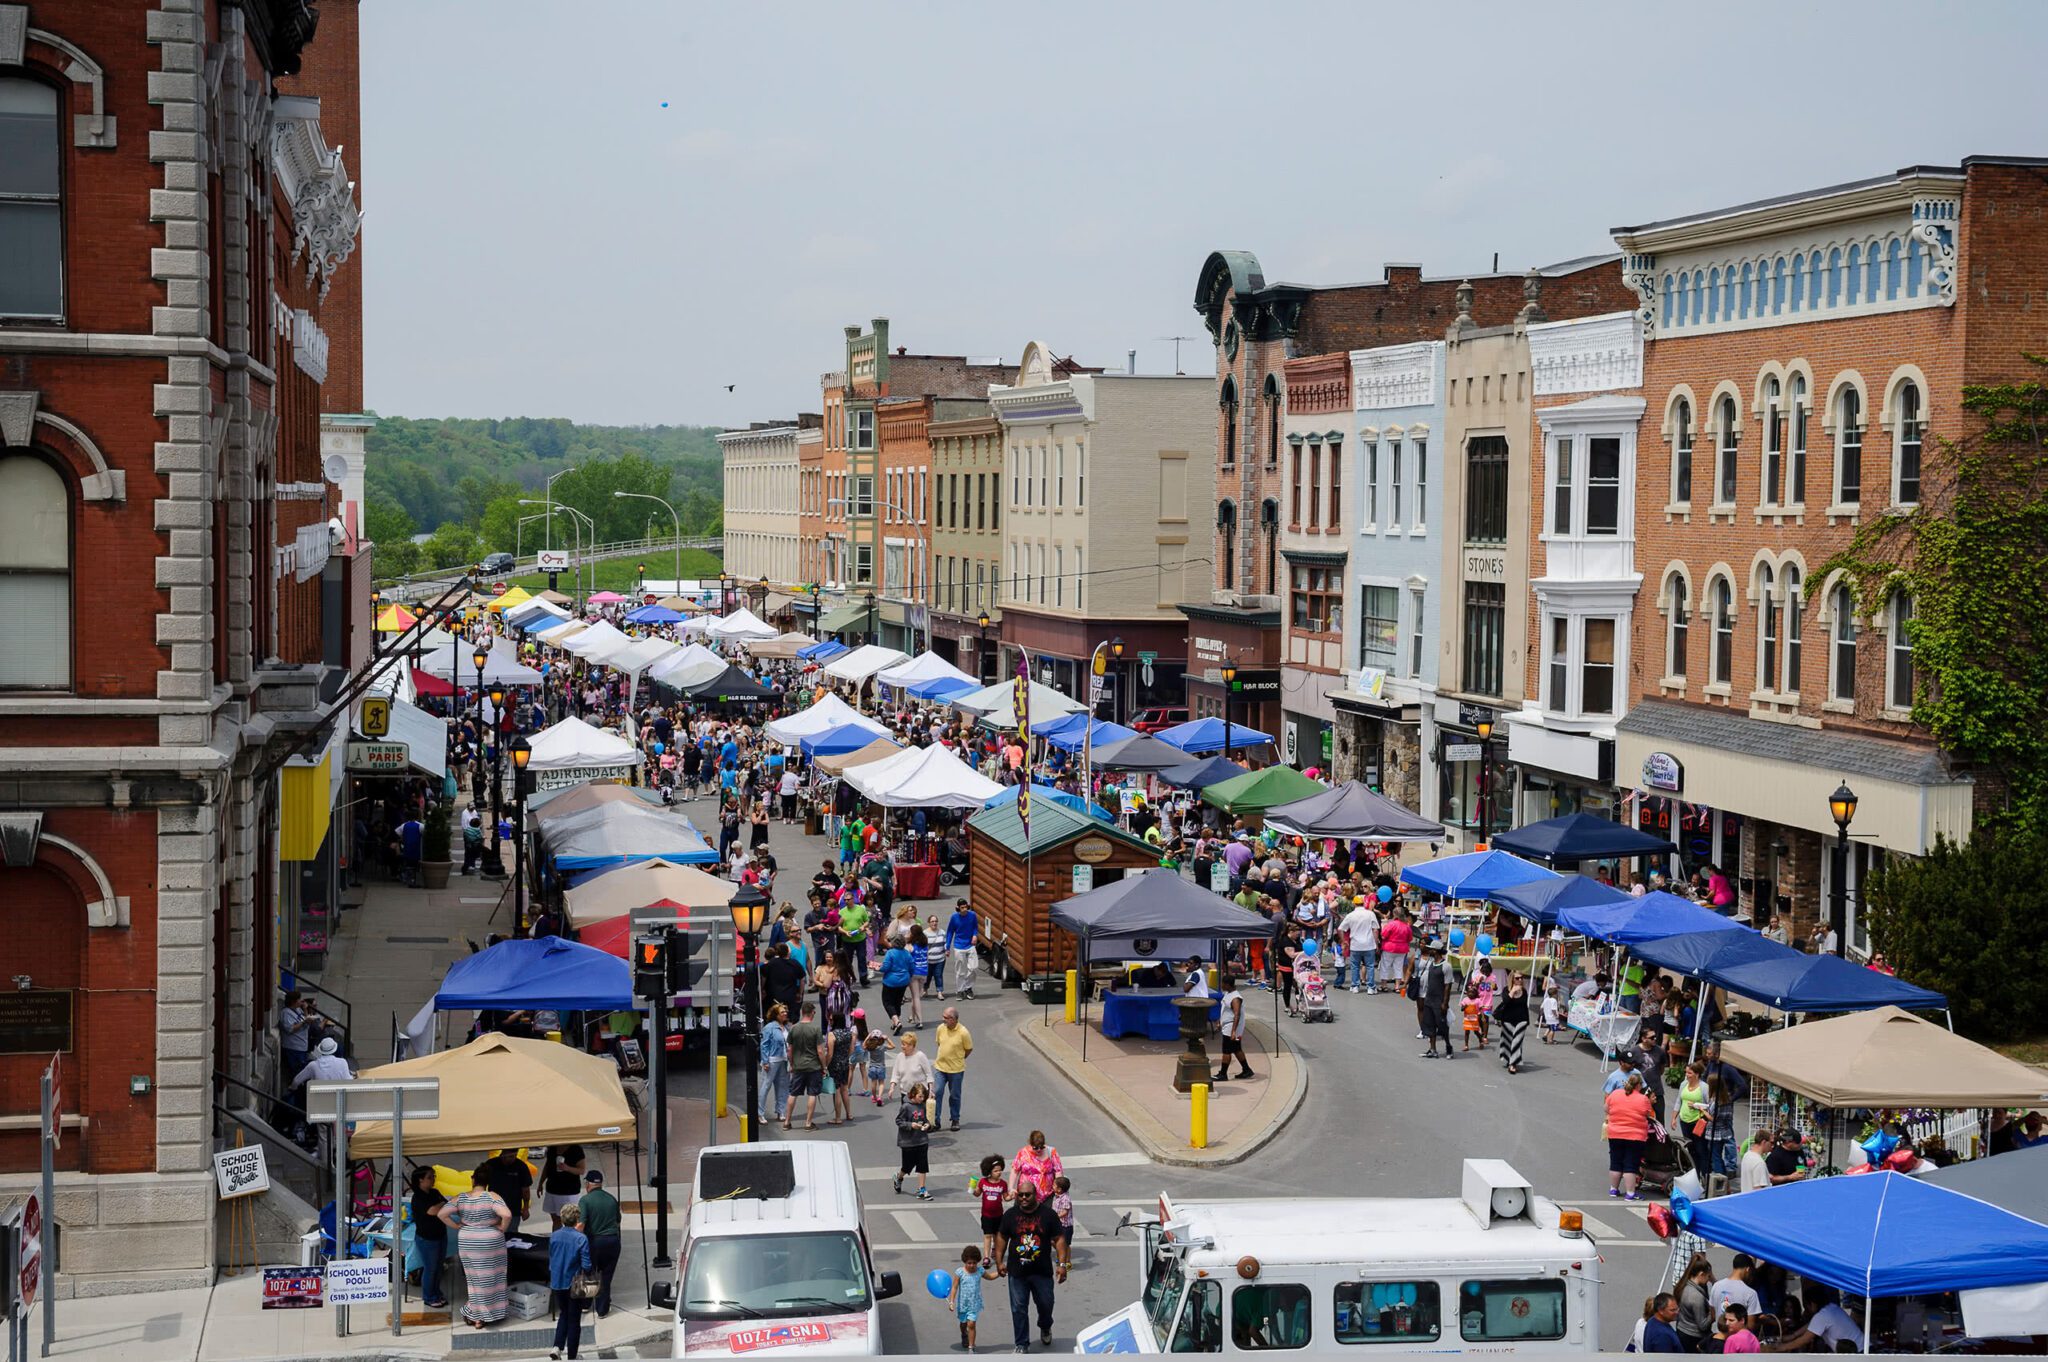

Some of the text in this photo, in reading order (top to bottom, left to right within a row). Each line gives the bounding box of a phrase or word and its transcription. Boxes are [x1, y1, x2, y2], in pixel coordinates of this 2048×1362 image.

[1468, 557, 1504, 573] STONE'S
[368, 753, 403, 762] PARIS
[541, 767, 625, 780] ADIRONDACK
[537, 780, 582, 791] KETT
[221, 1152, 259, 1167] SCHOOL
[226, 1162, 258, 1177] HOUSE
[329, 1267, 387, 1278] SCHOOL HOUSE
[270, 1281, 317, 1292] 107.7 GNA
[345, 1277, 371, 1286] POOLS
[329, 1291, 387, 1302] (518) 843-2820
[736, 1324, 820, 1345] 107.7 GNA
[781, 1337, 806, 1345] COUNTRY
